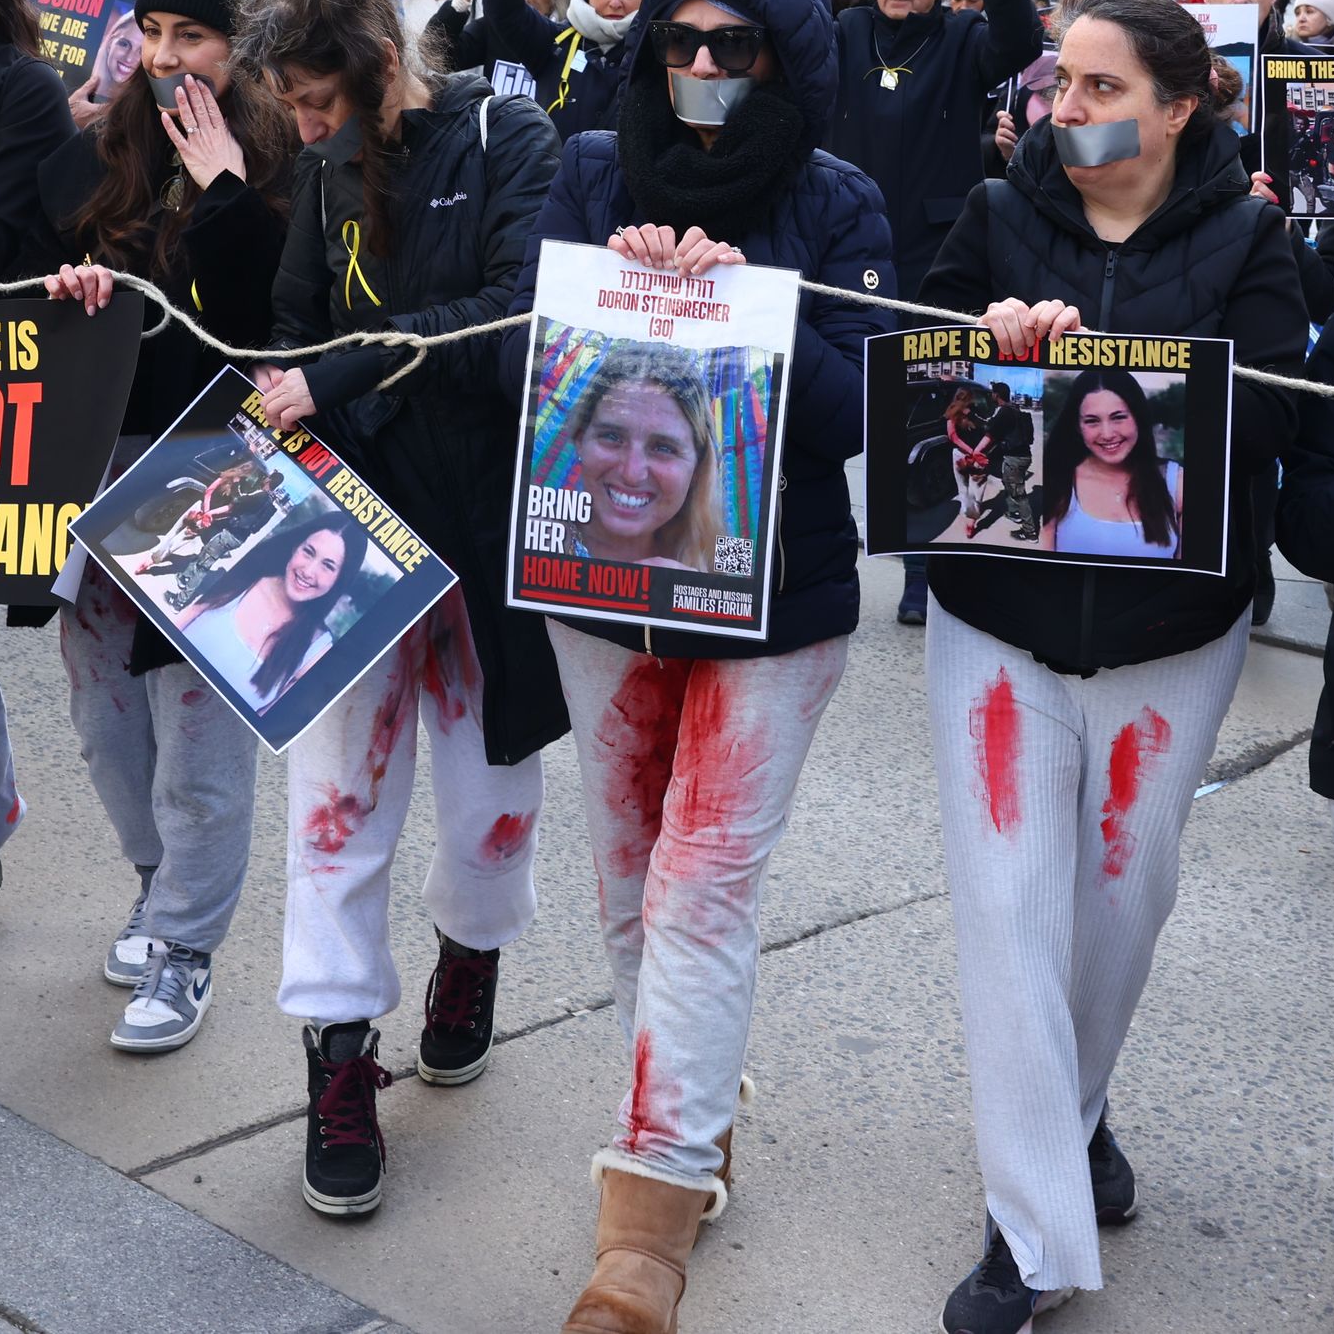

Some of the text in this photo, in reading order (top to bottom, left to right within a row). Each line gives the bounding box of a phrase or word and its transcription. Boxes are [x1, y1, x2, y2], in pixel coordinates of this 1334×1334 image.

[39, 12, 89, 40] WE ARE
[59, 43, 87, 66] FOR
[1268, 60, 1306, 80] BRING
[598, 288, 731, 323] DORON STEINBRECHER
[8, 320, 39, 371] IS
[648, 317, 674, 339] (30)
[903, 330, 1192, 369] RAPE IS RESISTANCE
[282, 428, 430, 573] IS NOT RESISTANCE
[527, 485, 592, 522] BRING
[524, 519, 566, 554] HER
[522, 555, 651, 601] HOME NOW!
[673, 584, 753, 604] HOSTAGES AND MISSING
[672, 595, 753, 618] FAMILIES FORUM
